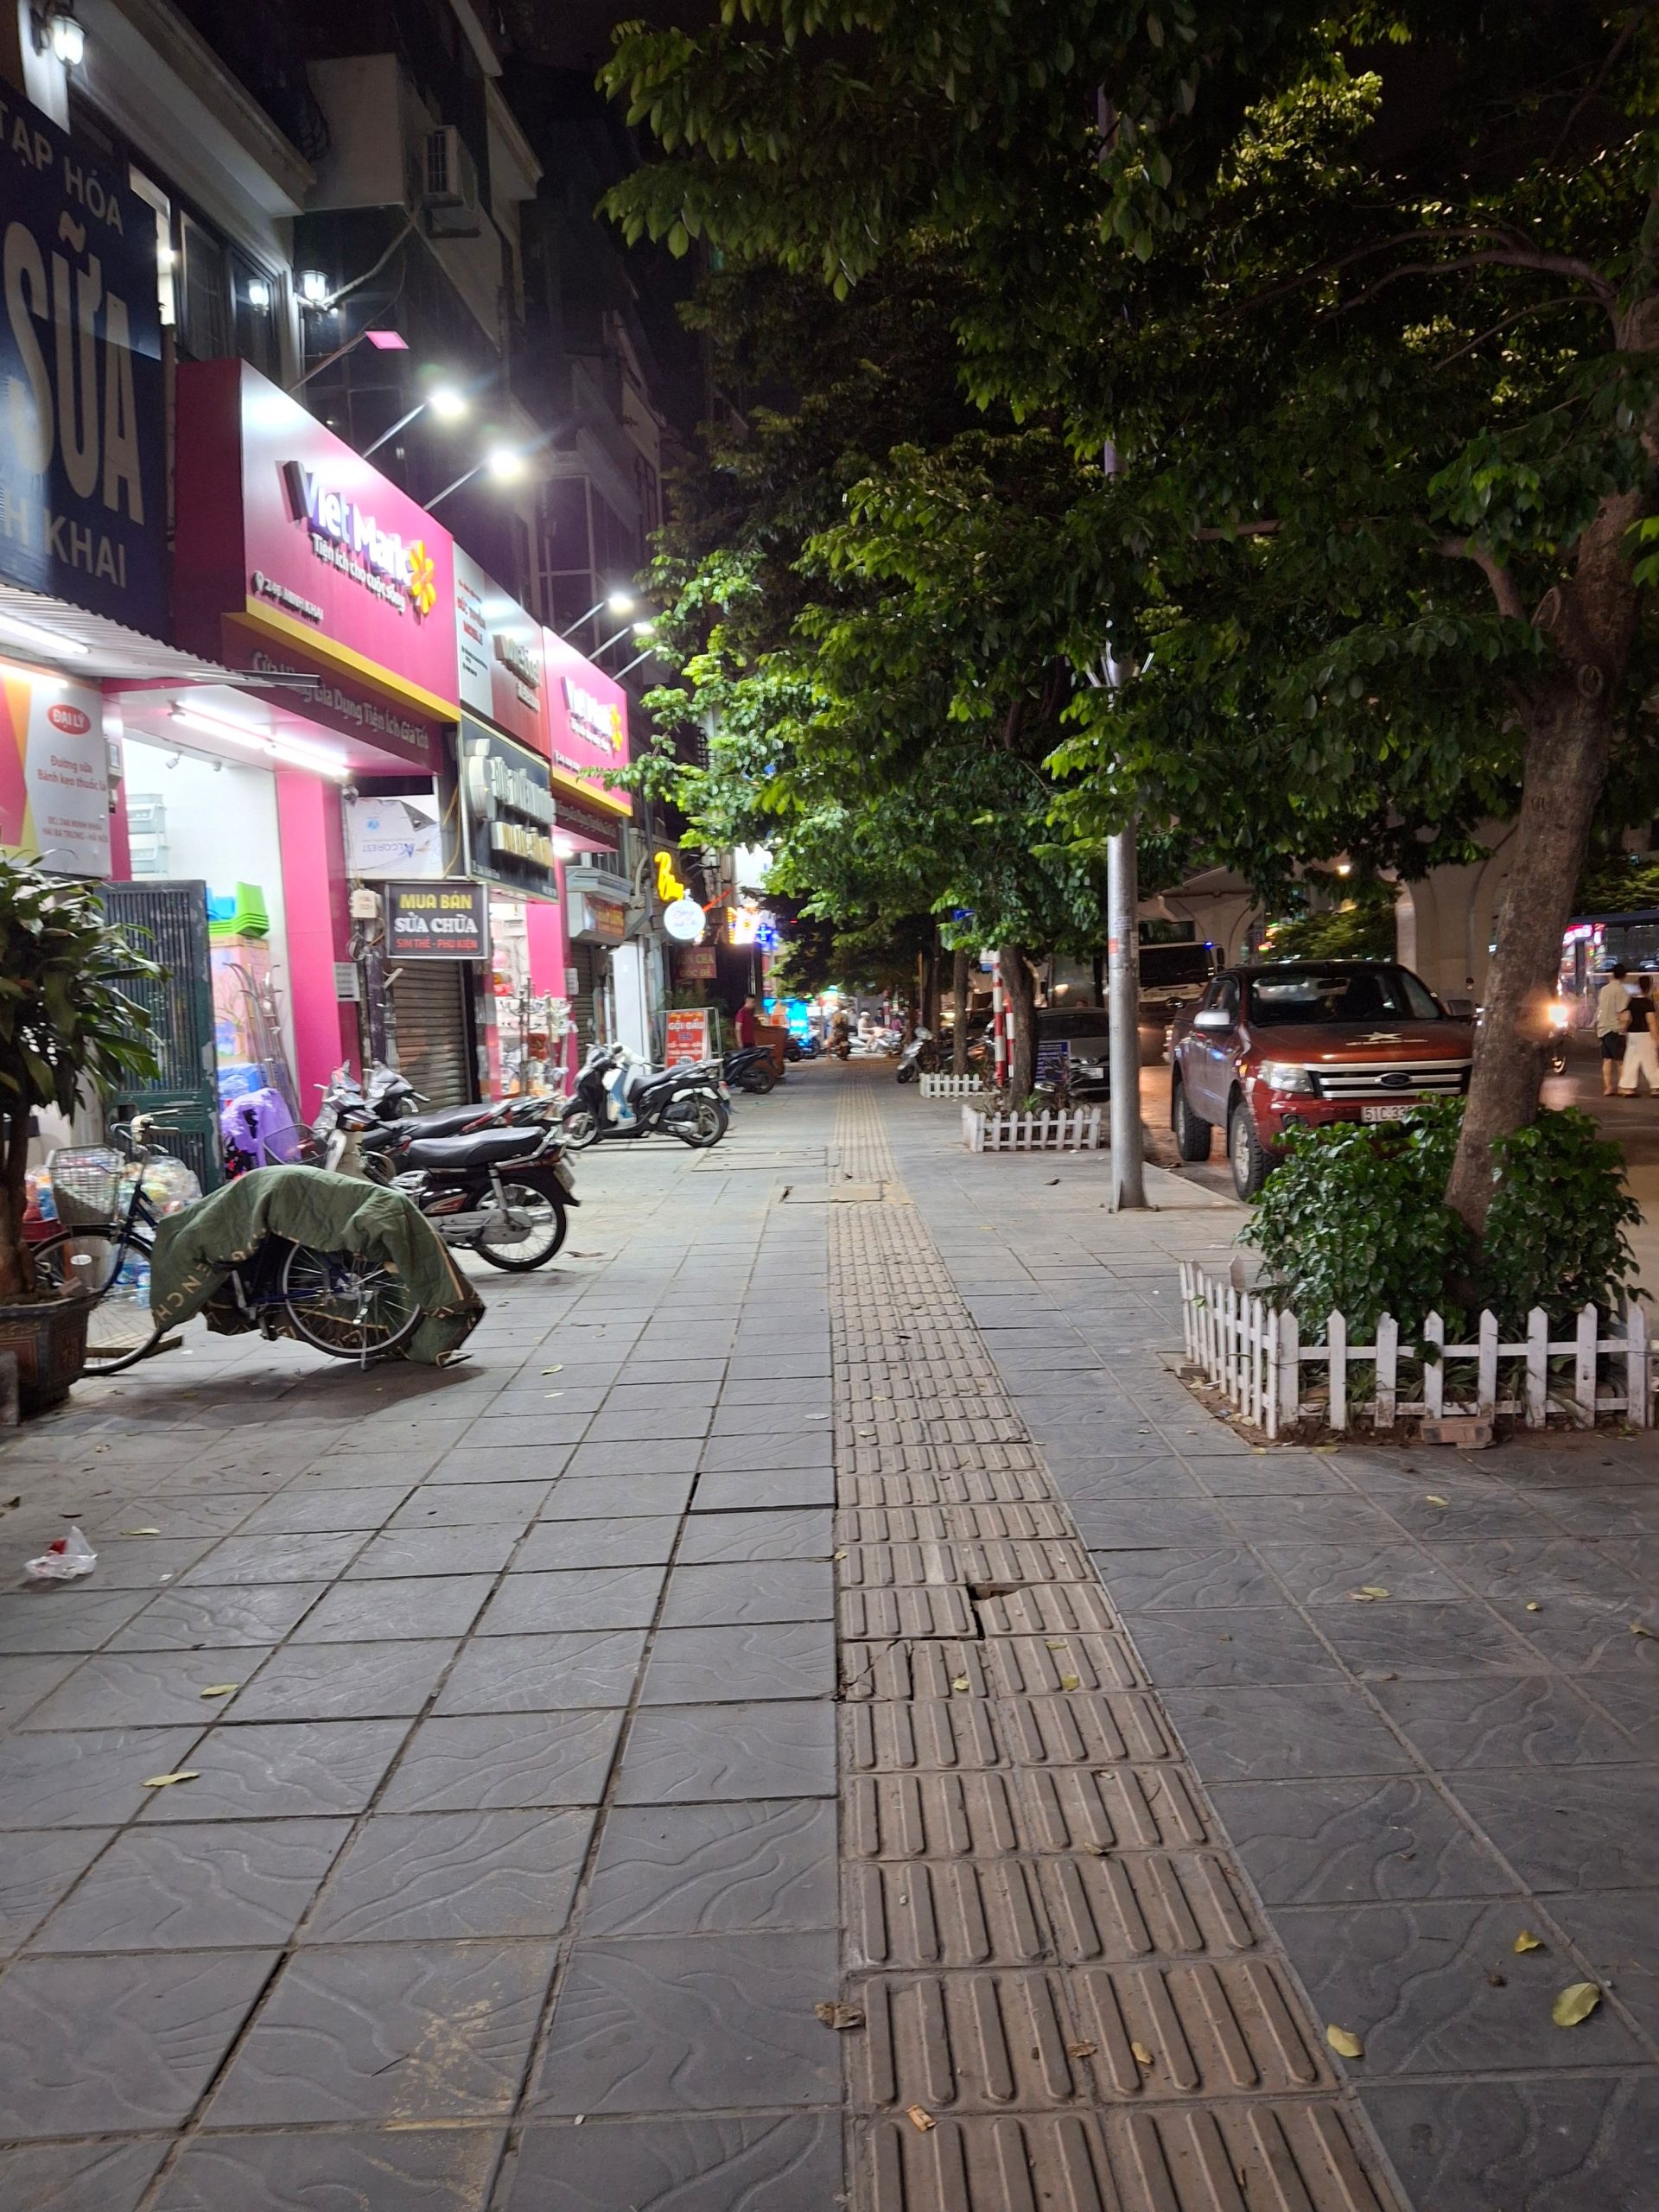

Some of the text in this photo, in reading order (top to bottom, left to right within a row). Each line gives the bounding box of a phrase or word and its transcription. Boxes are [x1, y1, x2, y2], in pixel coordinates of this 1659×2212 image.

[64, 156, 124, 237] HÓA
[3, 211, 144, 525] SỮA
[46, 507, 126, 588] KHAI
[52, 708, 86, 728] ĐẠI LÝ
[399, 893, 436, 909] MUA
[394, 911, 479, 934] SỬA CHỮA
[397, 938, 413, 949] SIM
